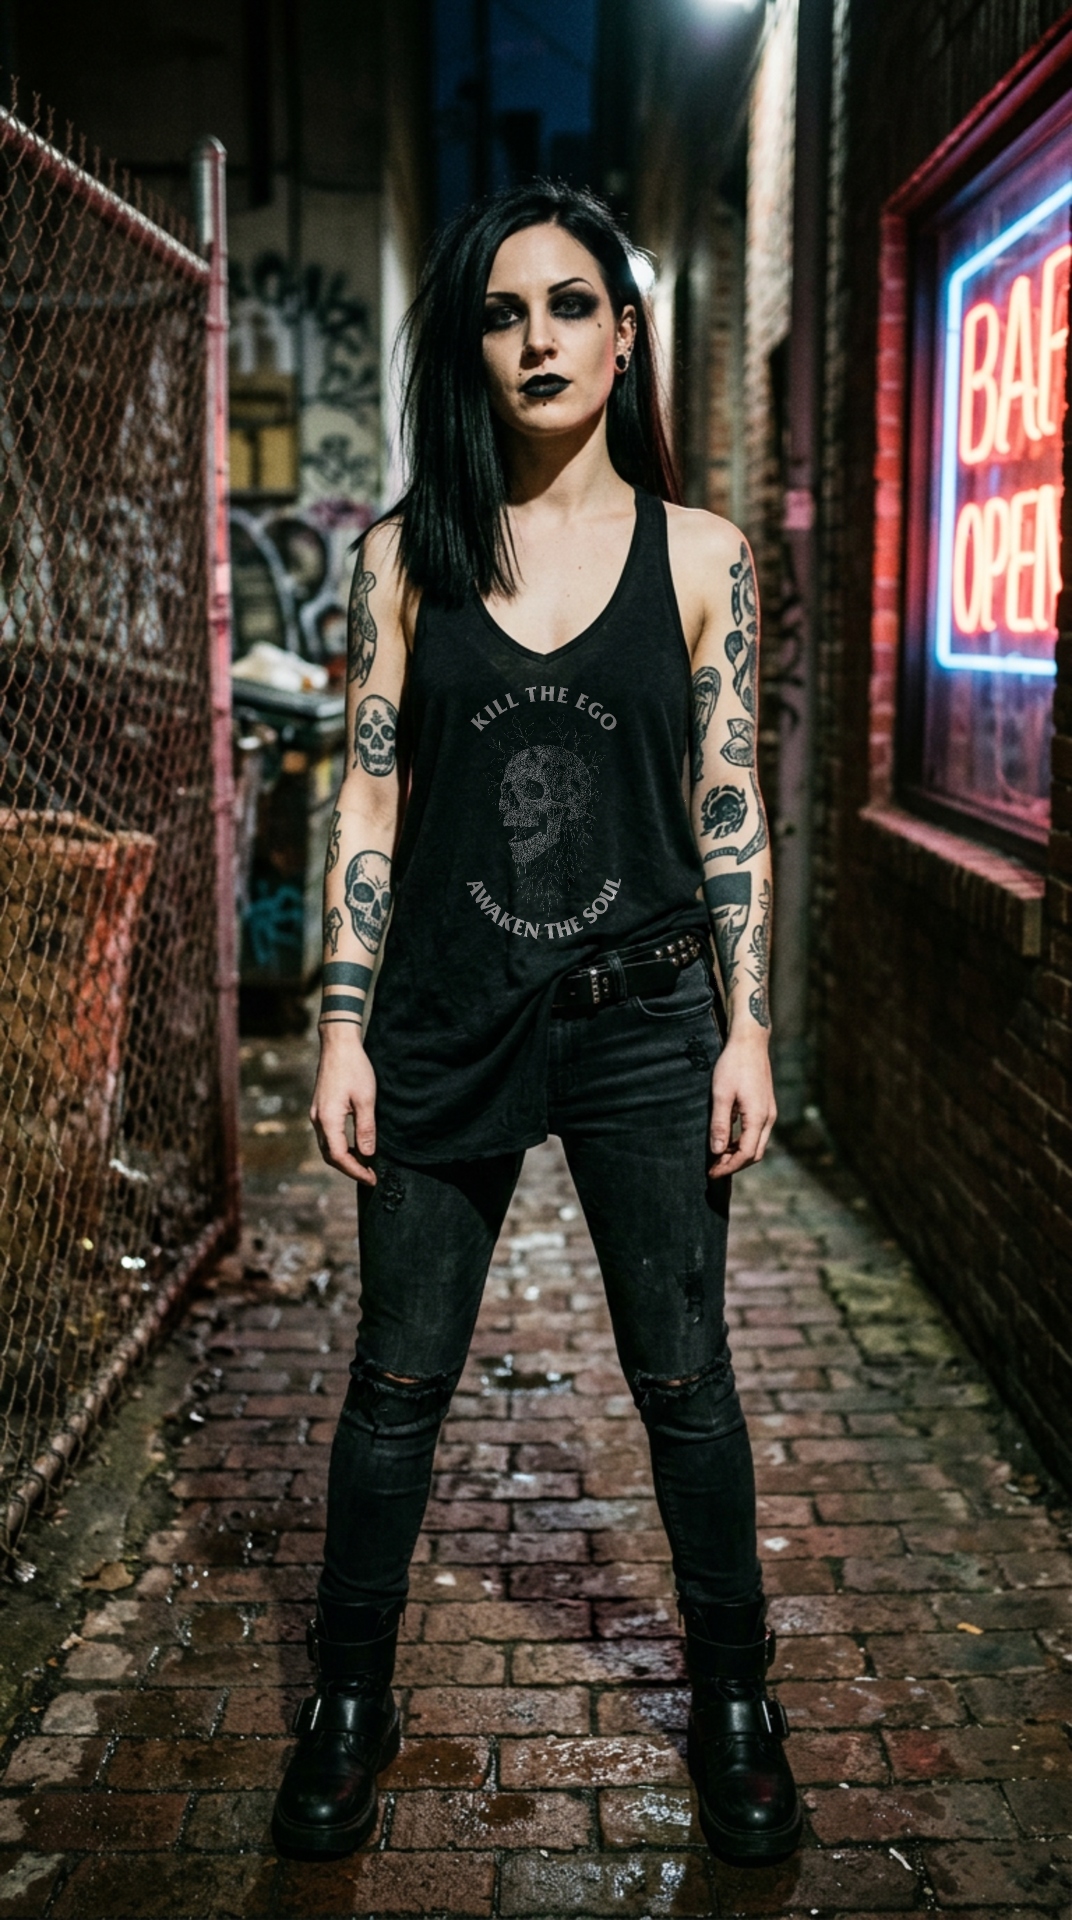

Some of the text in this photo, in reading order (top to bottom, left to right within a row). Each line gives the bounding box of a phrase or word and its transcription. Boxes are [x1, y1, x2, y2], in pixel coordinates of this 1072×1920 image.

[470, 685, 618, 732] KILL THE EGO
[466, 878, 622, 940] AWAKEN THE SOUL
